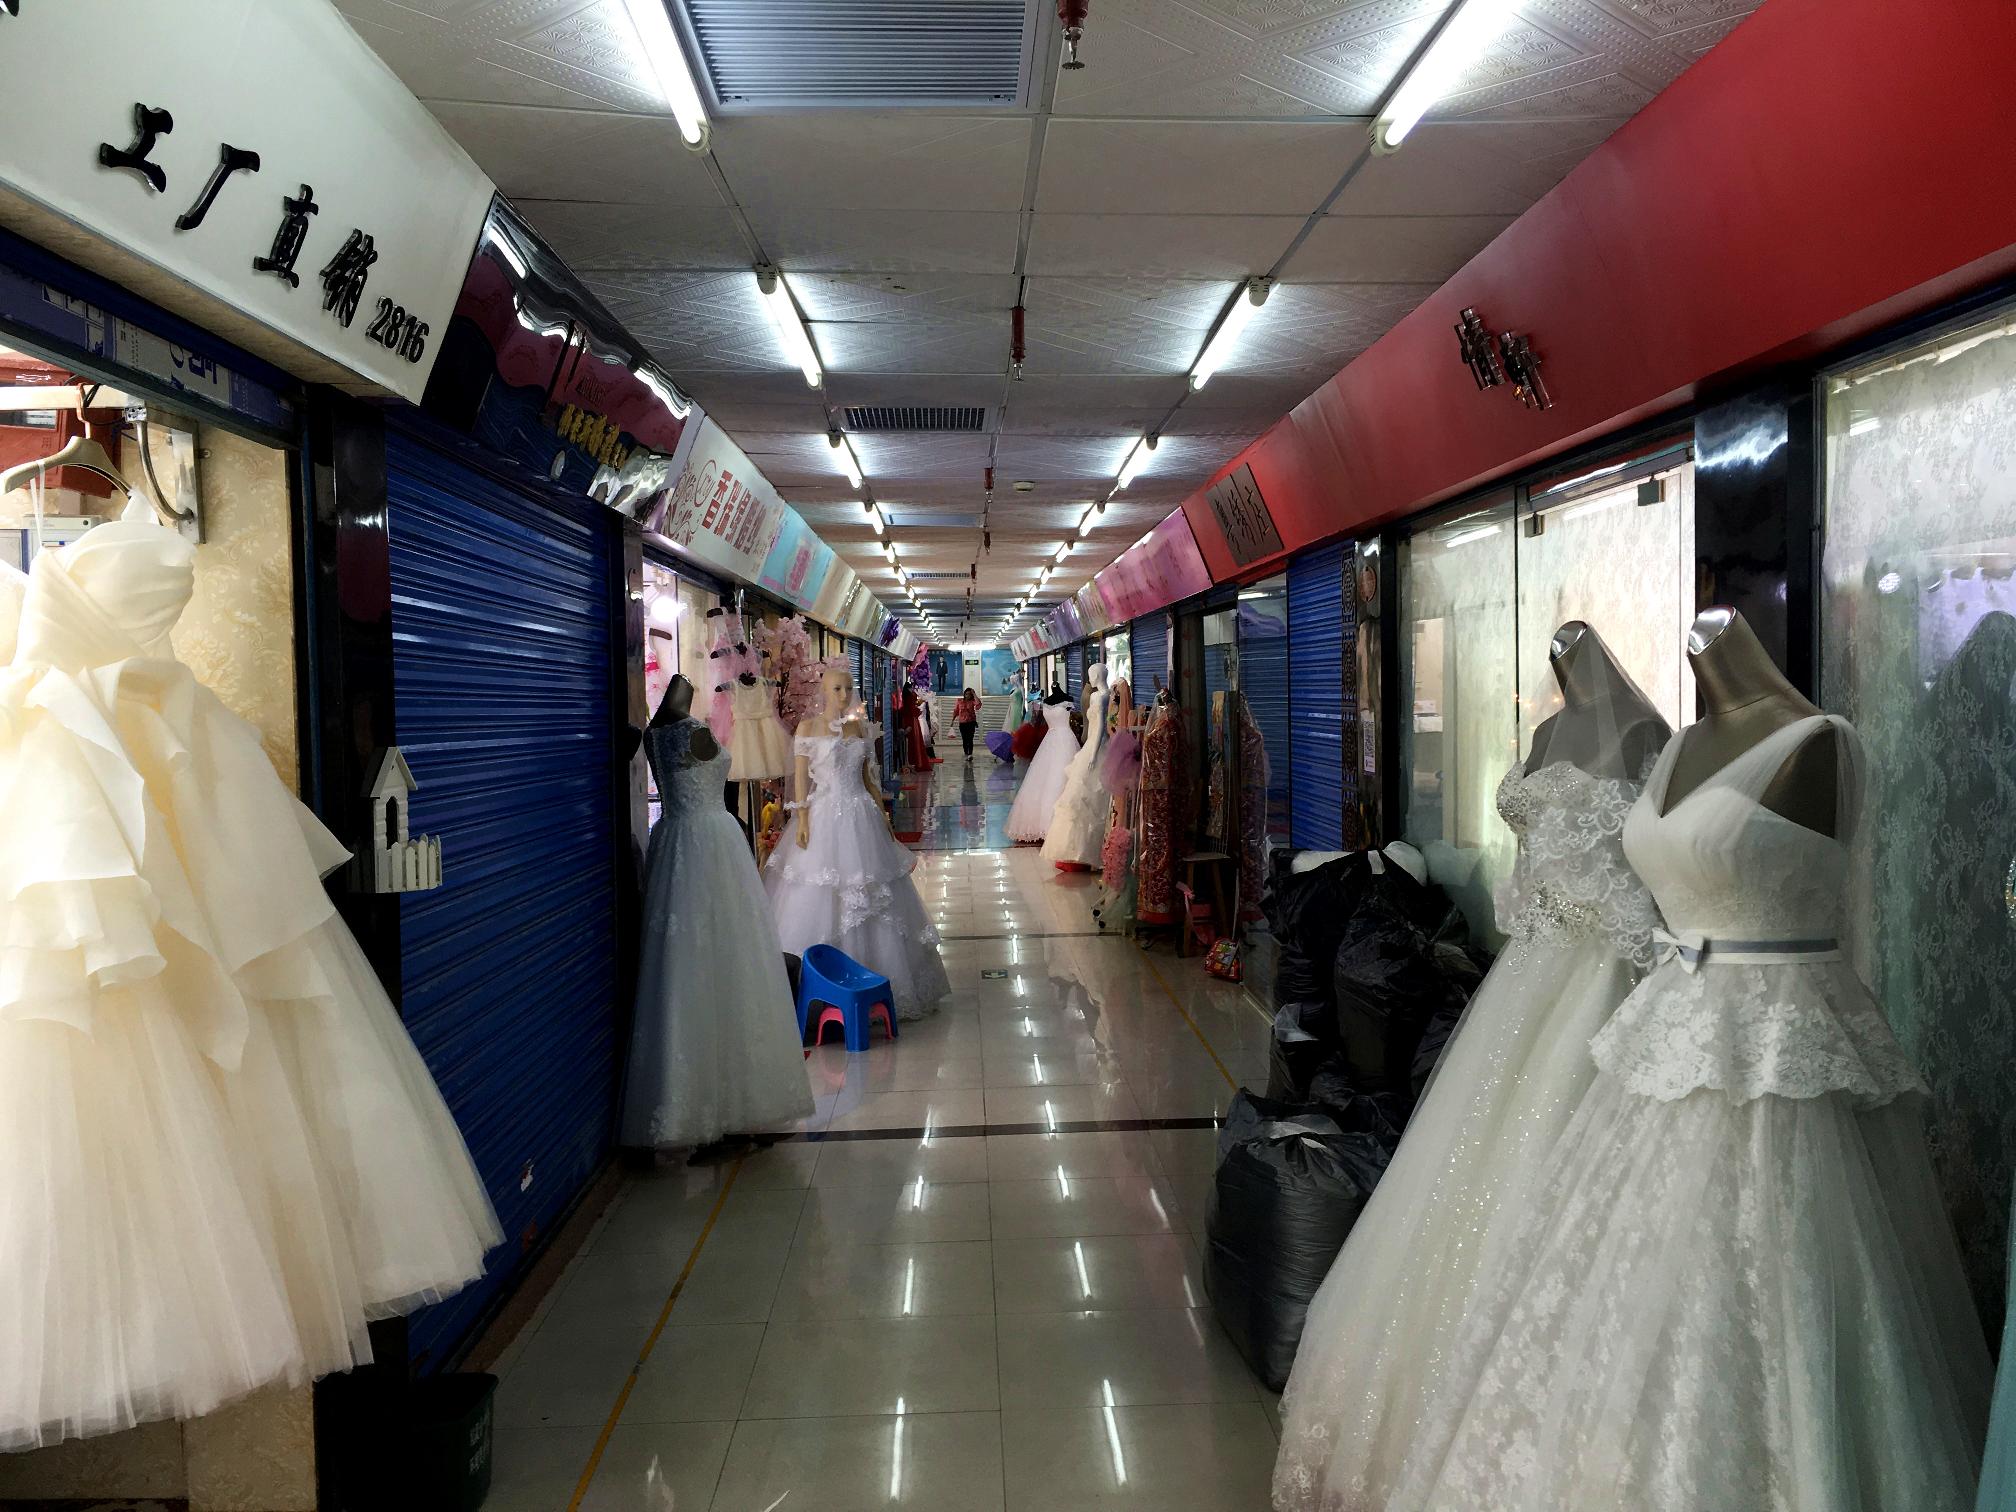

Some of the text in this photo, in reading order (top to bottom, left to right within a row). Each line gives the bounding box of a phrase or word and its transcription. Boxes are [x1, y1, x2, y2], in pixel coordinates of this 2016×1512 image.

[99, 102, 378, 328] 工厂直销
[365, 296, 430, 364] 2816
